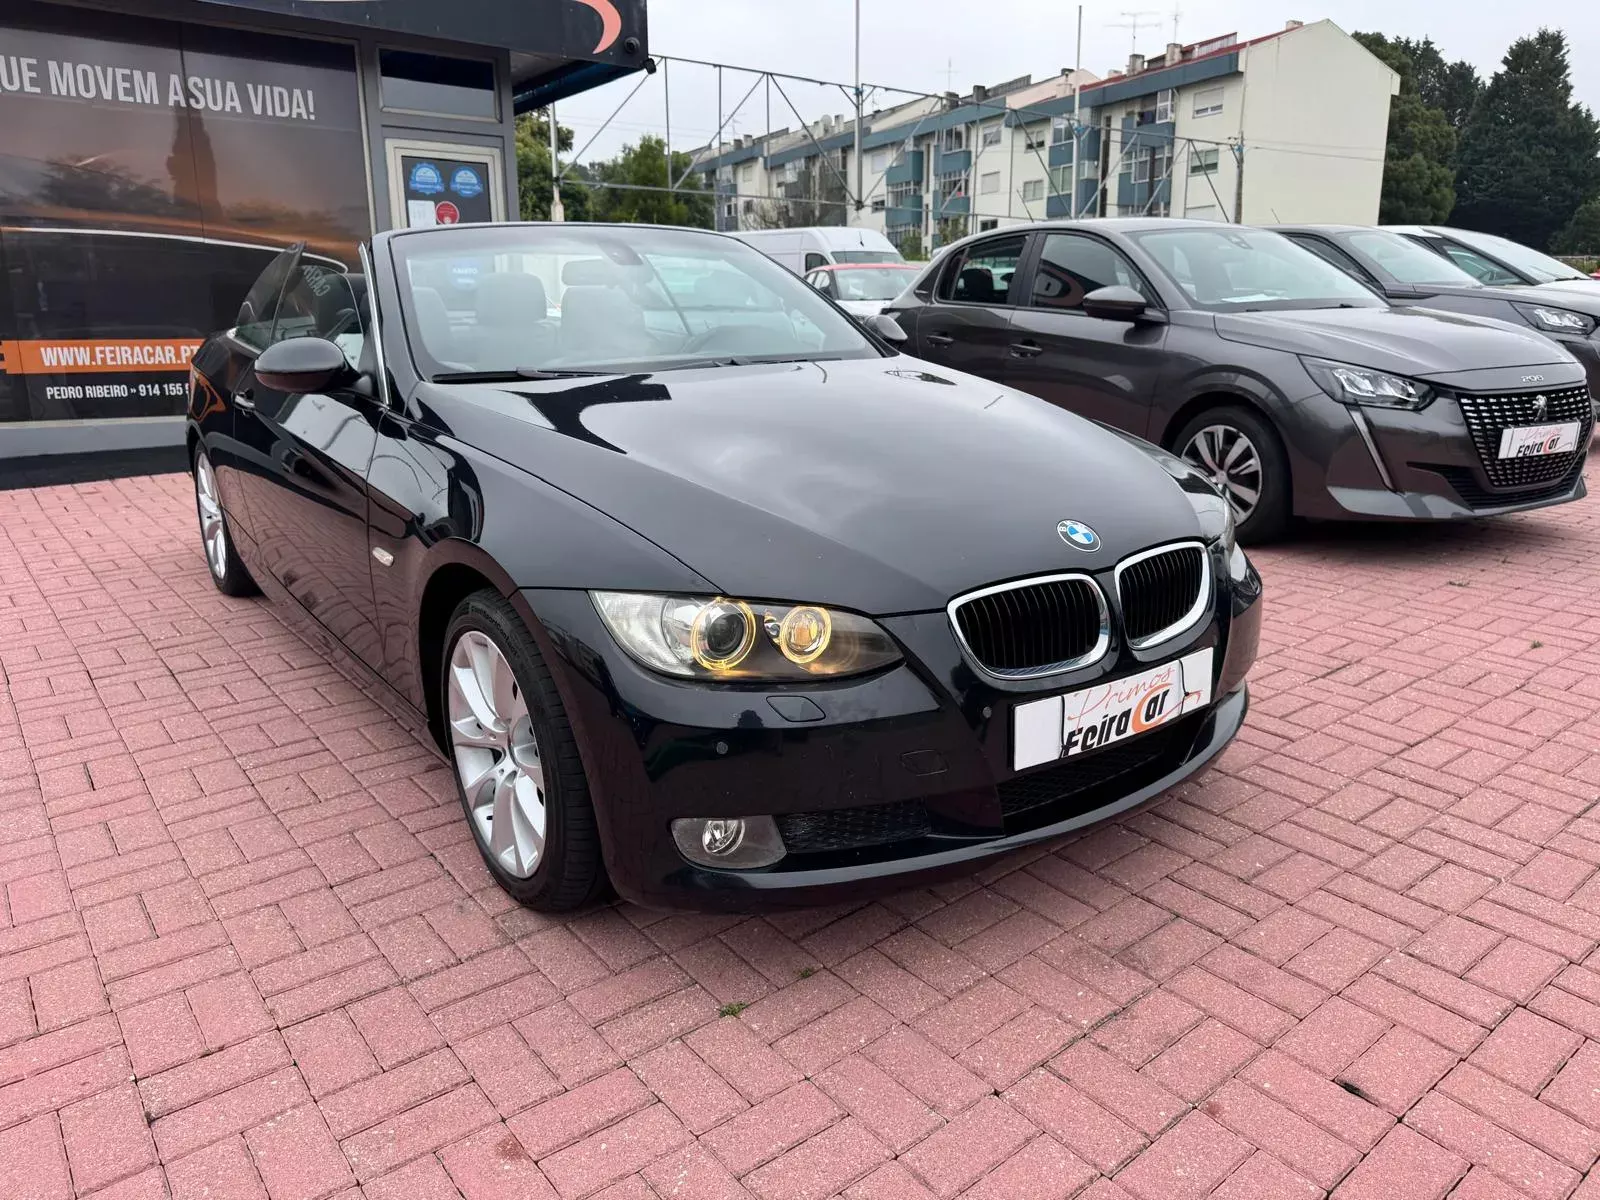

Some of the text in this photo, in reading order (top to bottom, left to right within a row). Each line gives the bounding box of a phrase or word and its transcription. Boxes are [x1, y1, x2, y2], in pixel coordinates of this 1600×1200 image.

[0, 55, 41, 94] UE
[48, 60, 160, 105] MOVEM
[247, 83, 315, 121] VIDA!
[40, 345, 200, 367] WWW.FEIRACAR.PT
[46, 386, 83, 400] PEDRO
[86, 385, 128, 398] RIBEIRO
[140, 384, 161, 397] 914
[163, 383, 183, 396] 155
